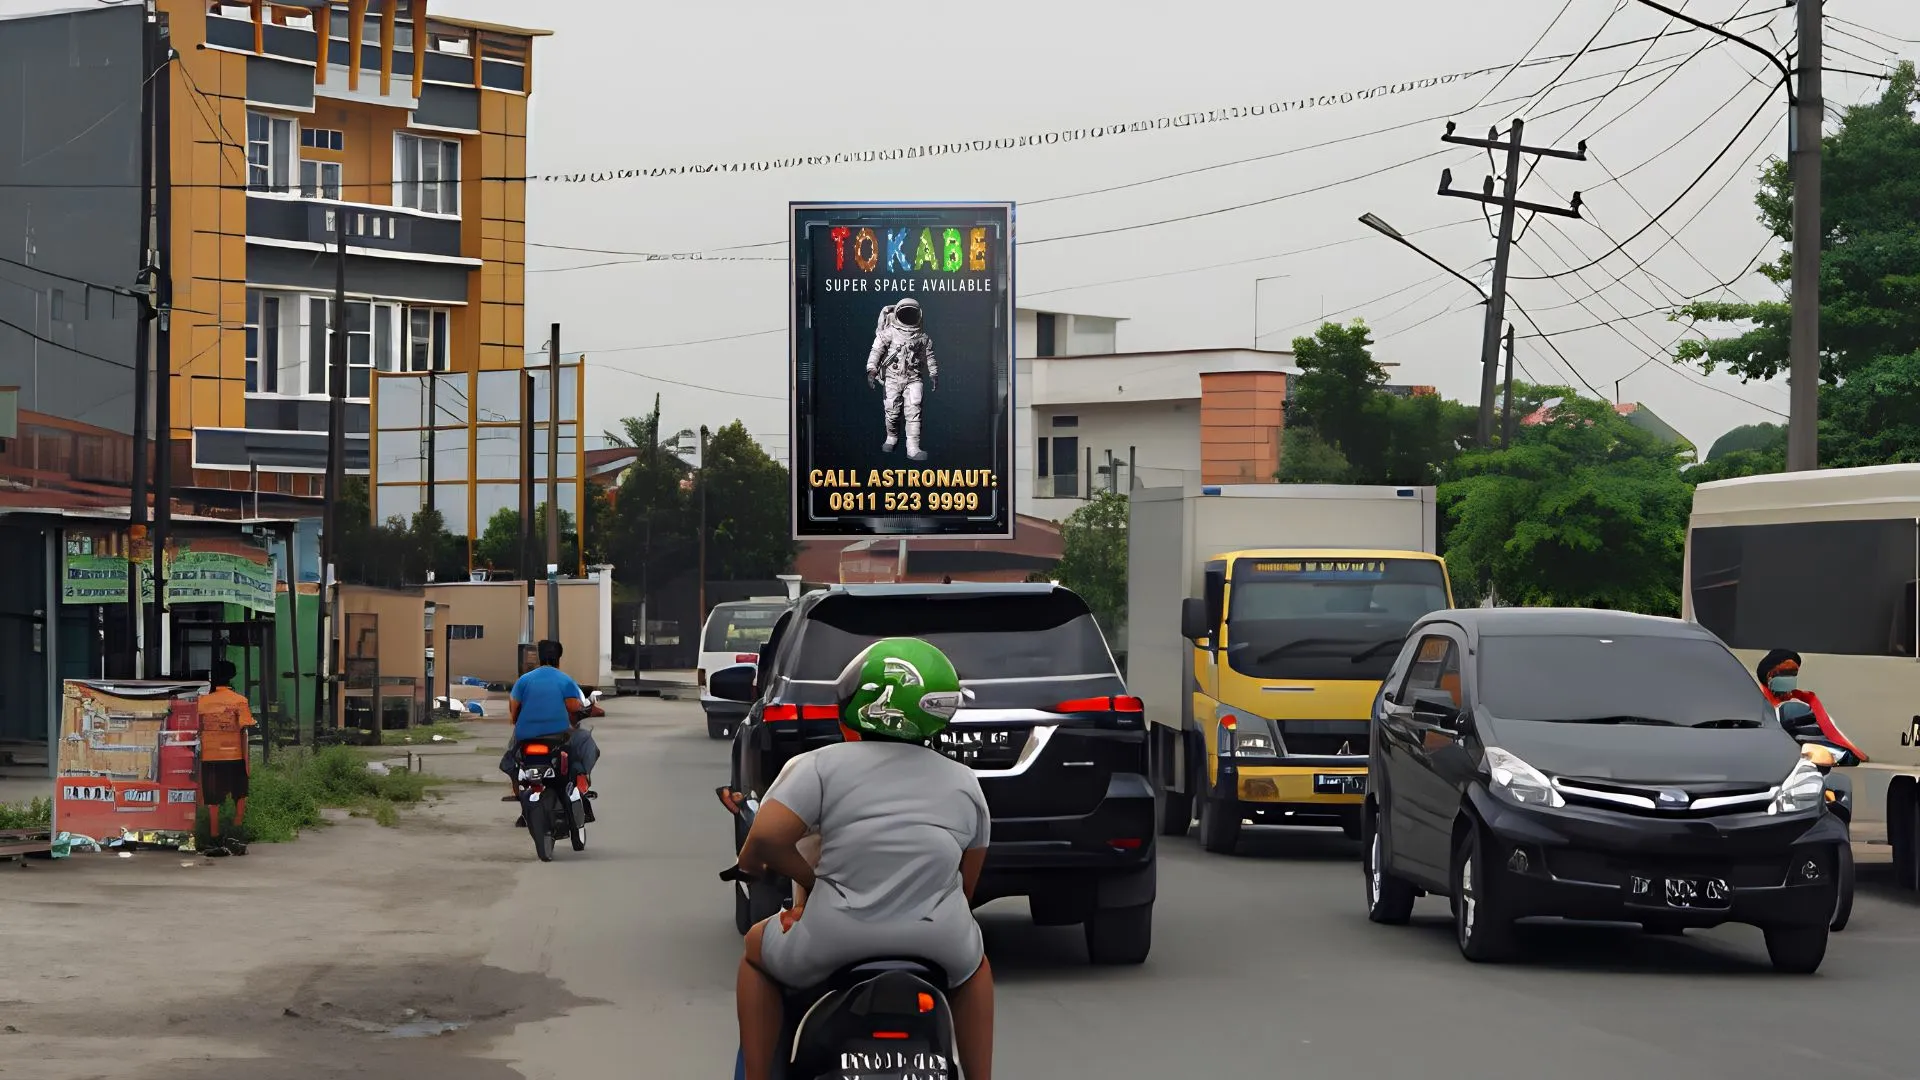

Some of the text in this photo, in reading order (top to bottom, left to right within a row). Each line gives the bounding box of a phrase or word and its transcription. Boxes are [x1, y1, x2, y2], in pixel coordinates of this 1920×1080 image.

[831, 227, 987, 272] TOKABE
[825, 278, 992, 292] SUPER SPACE AVAILABLE
[809, 469, 998, 487] CALL ASTRONAUT:
[829, 492, 979, 511] 0811 523 9999
